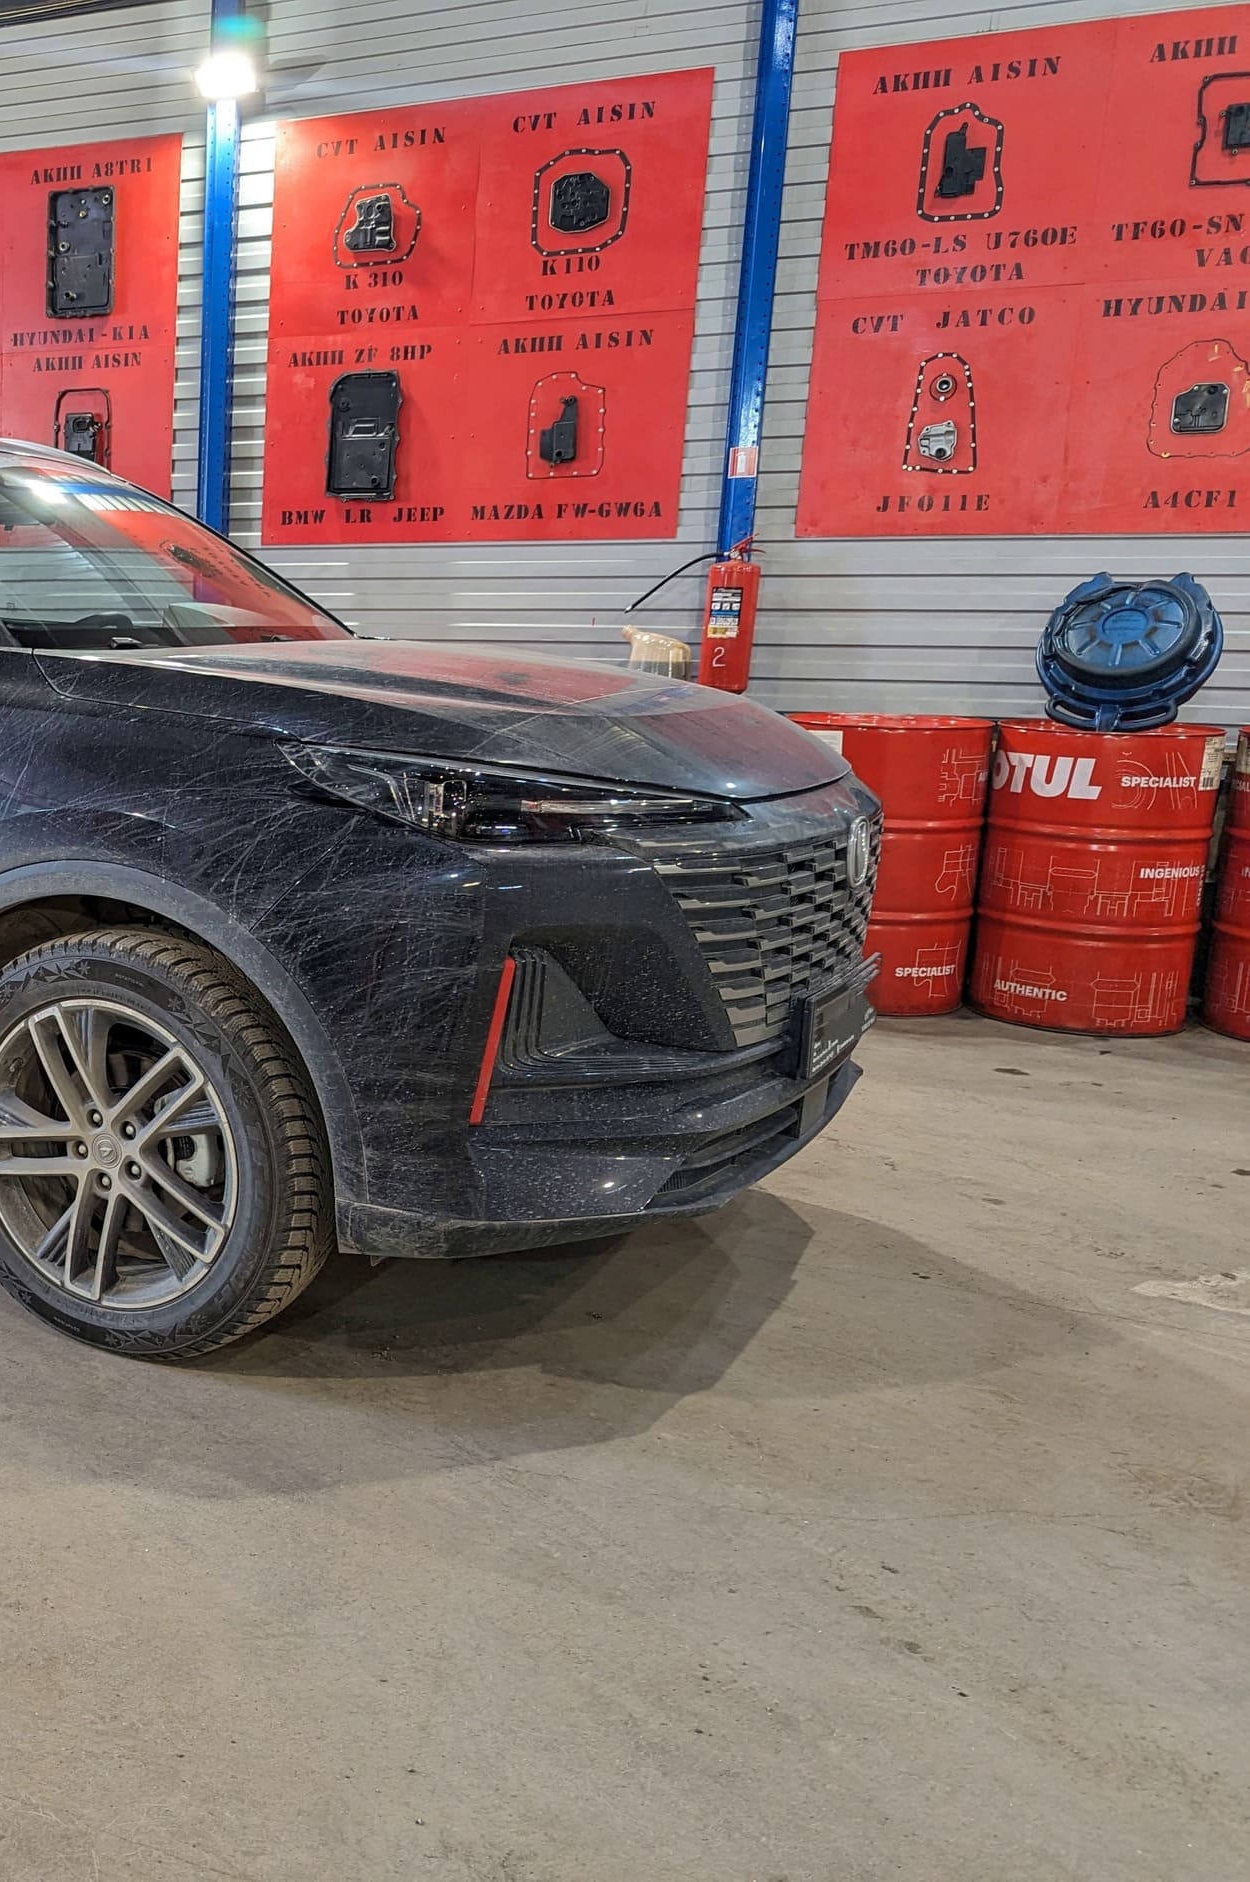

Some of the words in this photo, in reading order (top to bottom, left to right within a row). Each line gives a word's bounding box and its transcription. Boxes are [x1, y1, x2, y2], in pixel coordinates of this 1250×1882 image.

[967, 55, 1064, 85] AISIN
[512, 111, 560, 133] CVT
[577, 101, 656, 126] AISIN
[317, 138, 359, 161] CVT
[373, 126, 446, 151] AISIN
[1111, 213, 1247, 242] TF60-SN
[844, 234, 967, 261] TM60-LS
[986, 225, 1078, 251] U760E
[915, 262, 1027, 287] TOYOTA
[525, 289, 615, 311] TOYOTA
[1102, 290, 1248, 318] HYUNDAI
[336, 304, 422, 326] TOYOTA
[851, 314, 904, 335] CVT
[935, 306, 1036, 329] JATCO
[574, 329, 657, 353] AISIN
[354, 345, 378, 364] ZF
[389, 344, 433, 362] 8HP
[875, 494, 990, 513] JF011E
[1142, 489, 1237, 509] A4CF1
[281, 509, 326, 526] BMW
[344, 508, 372, 524] LR
[392, 506, 445, 523] JEEP
[472, 503, 547, 521] MAZDA
[712, 646, 726, 667] 2
[992, 749, 1103, 800] OTUL
[1121, 775, 1197, 788] SPECIALIST
[1139, 865, 1200, 879] INGENIOUS
[894, 964, 956, 978] SPECIALIST
[994, 979, 1068, 1002] AUTHENTIC
